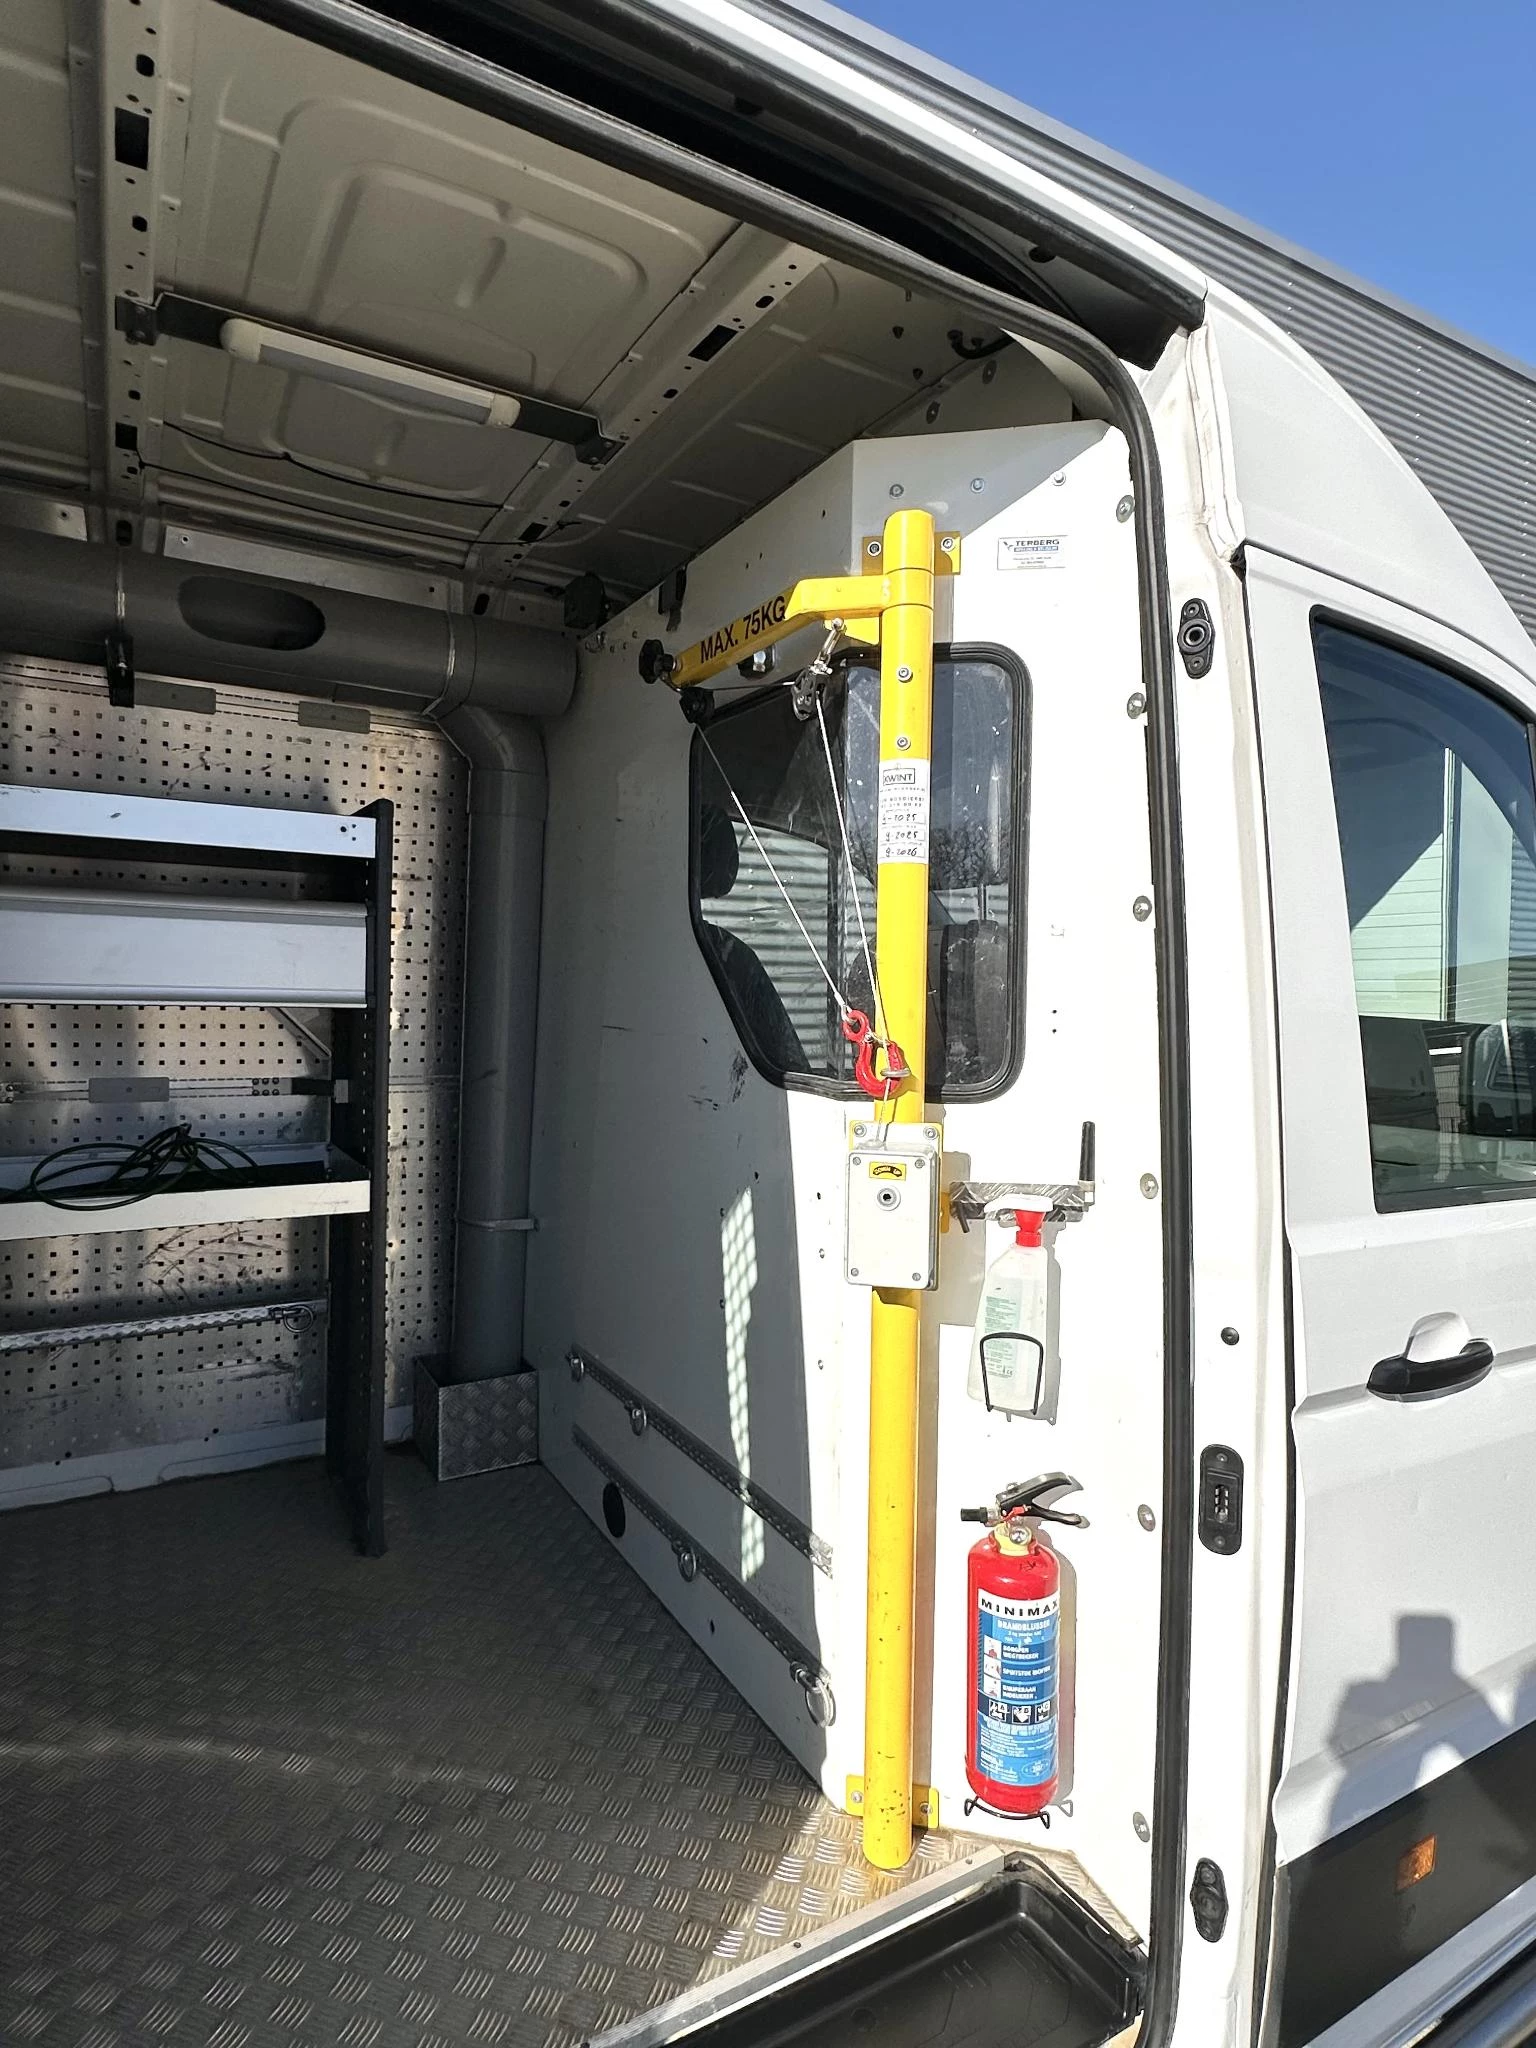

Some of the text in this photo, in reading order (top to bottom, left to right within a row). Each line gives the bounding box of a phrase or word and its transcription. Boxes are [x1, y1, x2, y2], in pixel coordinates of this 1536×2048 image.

[700, 595, 786, 664] MAX. 75KG
[981, 1598, 1058, 1617] MINIMAX
[997, 1619, 1050, 1631] BRANDBLUSSER
